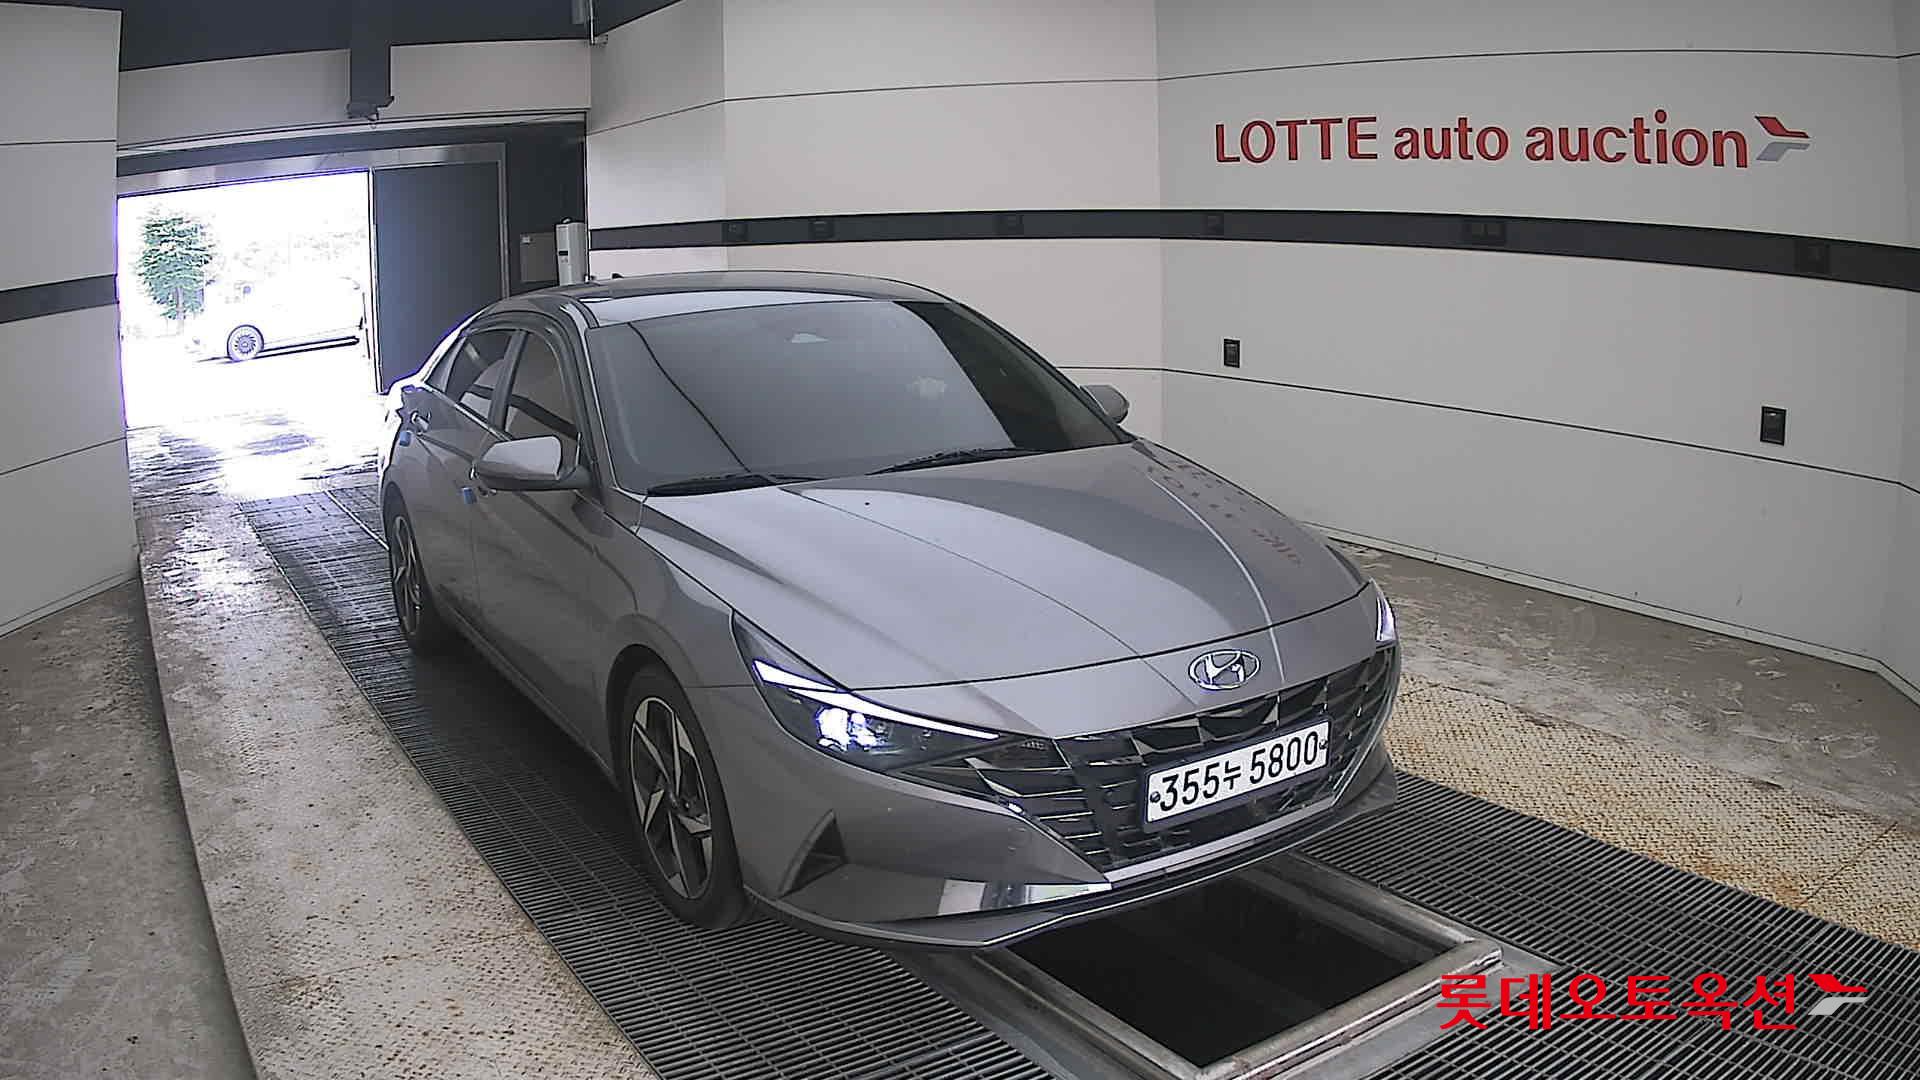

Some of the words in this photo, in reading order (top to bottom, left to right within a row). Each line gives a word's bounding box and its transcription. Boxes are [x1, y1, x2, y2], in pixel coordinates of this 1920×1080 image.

[1215, 116, 1378, 164] LOTTE
[1393, 116, 1509, 162] auto
[1524, 109, 1749, 169] auction
[1160, 761, 1241, 812] 355누
[1250, 731, 1319, 784] 5800
